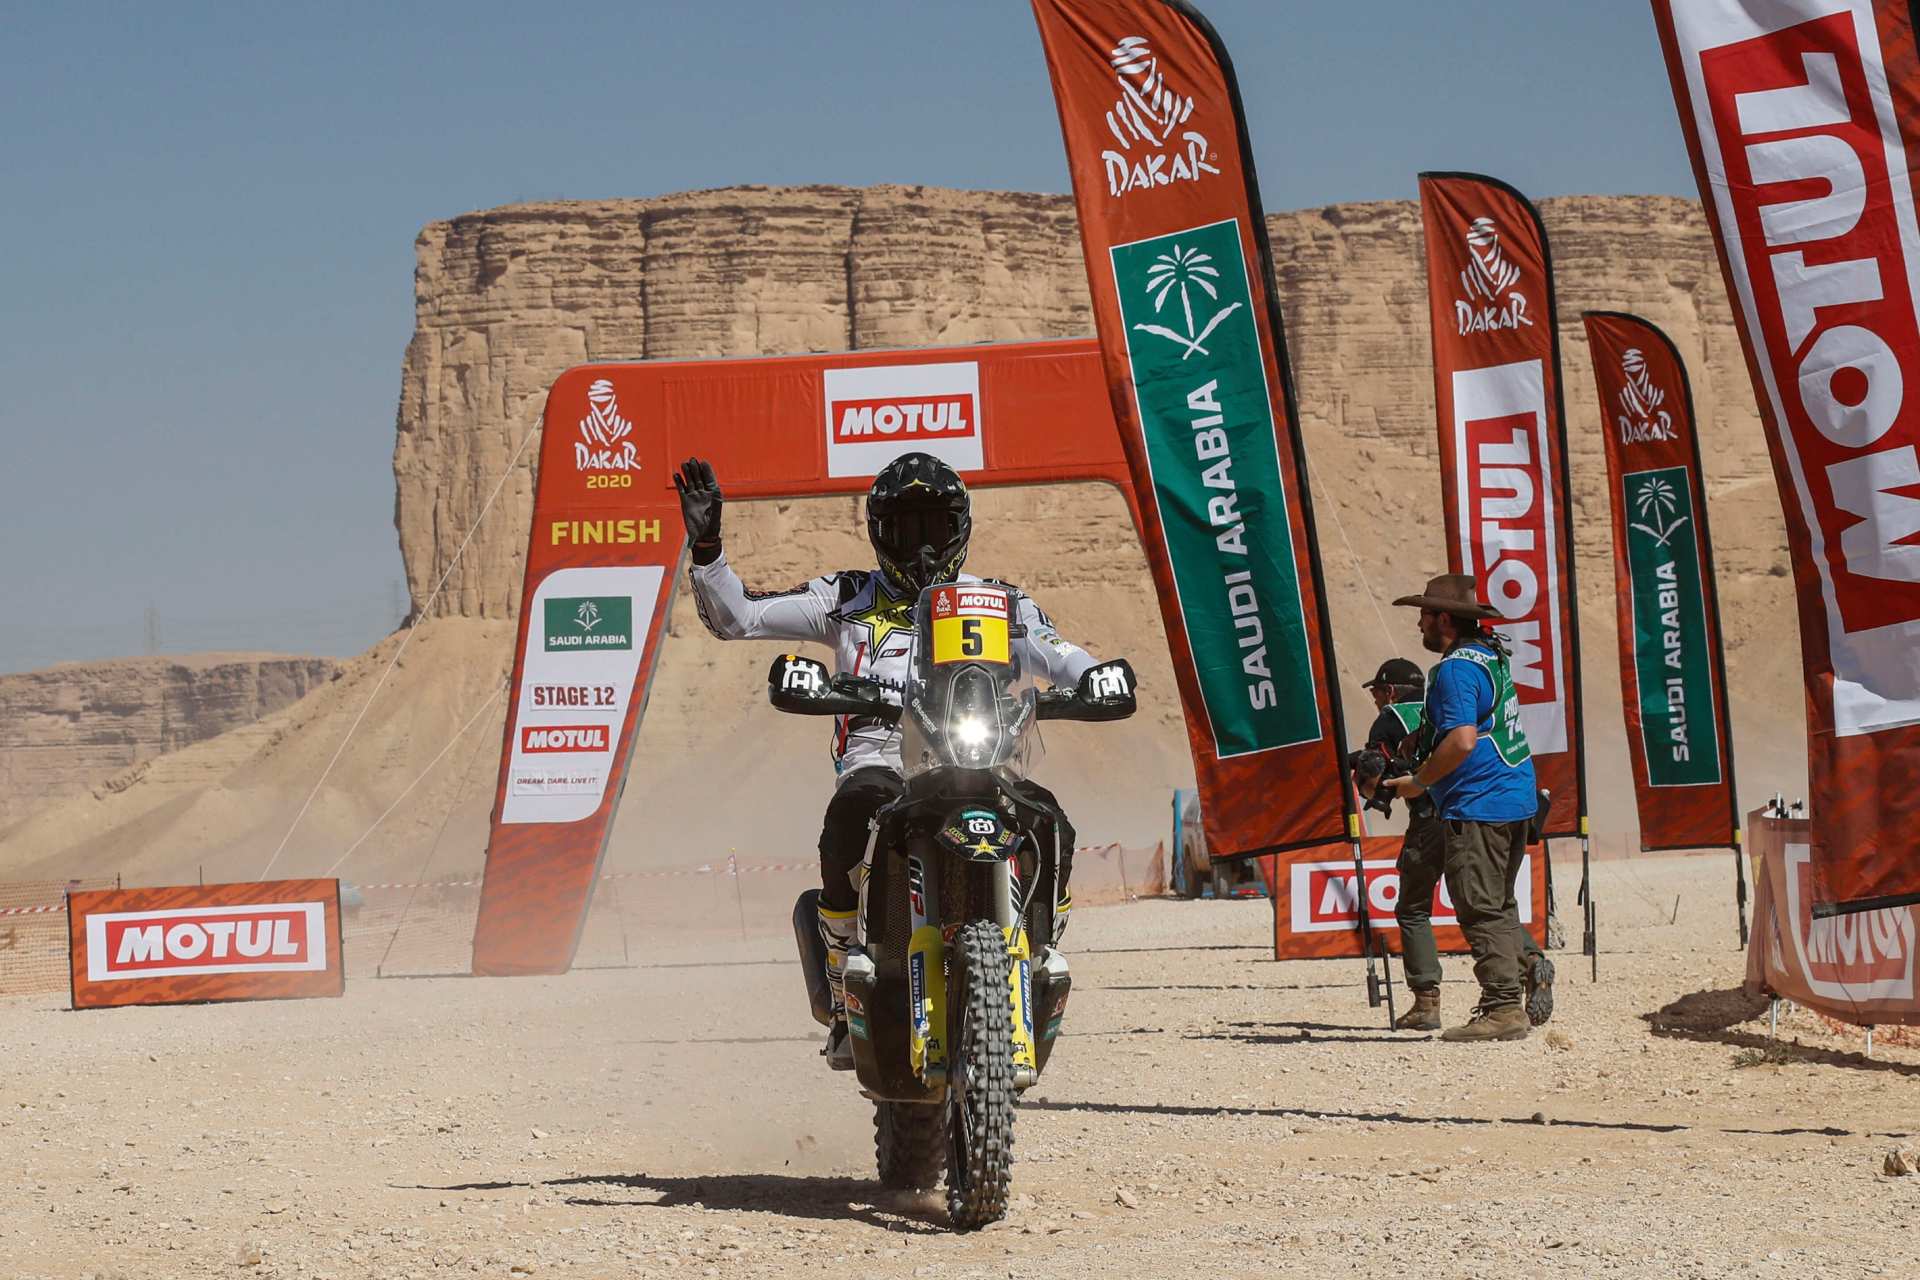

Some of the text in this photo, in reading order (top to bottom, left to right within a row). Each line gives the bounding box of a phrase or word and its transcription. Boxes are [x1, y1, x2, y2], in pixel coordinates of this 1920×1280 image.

[1101, 131, 1220, 197] DAKAR
[1455, 291, 1533, 336] DAKAR
[1735, 52, 1920, 583] MOTUL
[840, 402, 967, 436] MOTUL
[1618, 410, 1679, 445] DAKAR
[574, 441, 642, 471] DAKAR
[587, 474, 632, 489] 2020
[552, 519, 661, 545] FINISH
[1187, 379, 1277, 711] SAUDI ARABIA
[1478, 427, 1545, 690] MOTUL
[960, 595, 1005, 609] MOTUL
[549, 635, 627, 646] SAUDI ARABIA
[962, 620, 983, 656] 5
[1656, 561, 1690, 762] SAUDI ARABIA
[534, 686, 615, 706] STAGE 12
[526, 730, 605, 748] MOTUL
[115, 919, 298, 963] MOTUL
[912, 958, 921, 1019] MICHELIN
[1022, 962, 1032, 1023] MICHELIN
